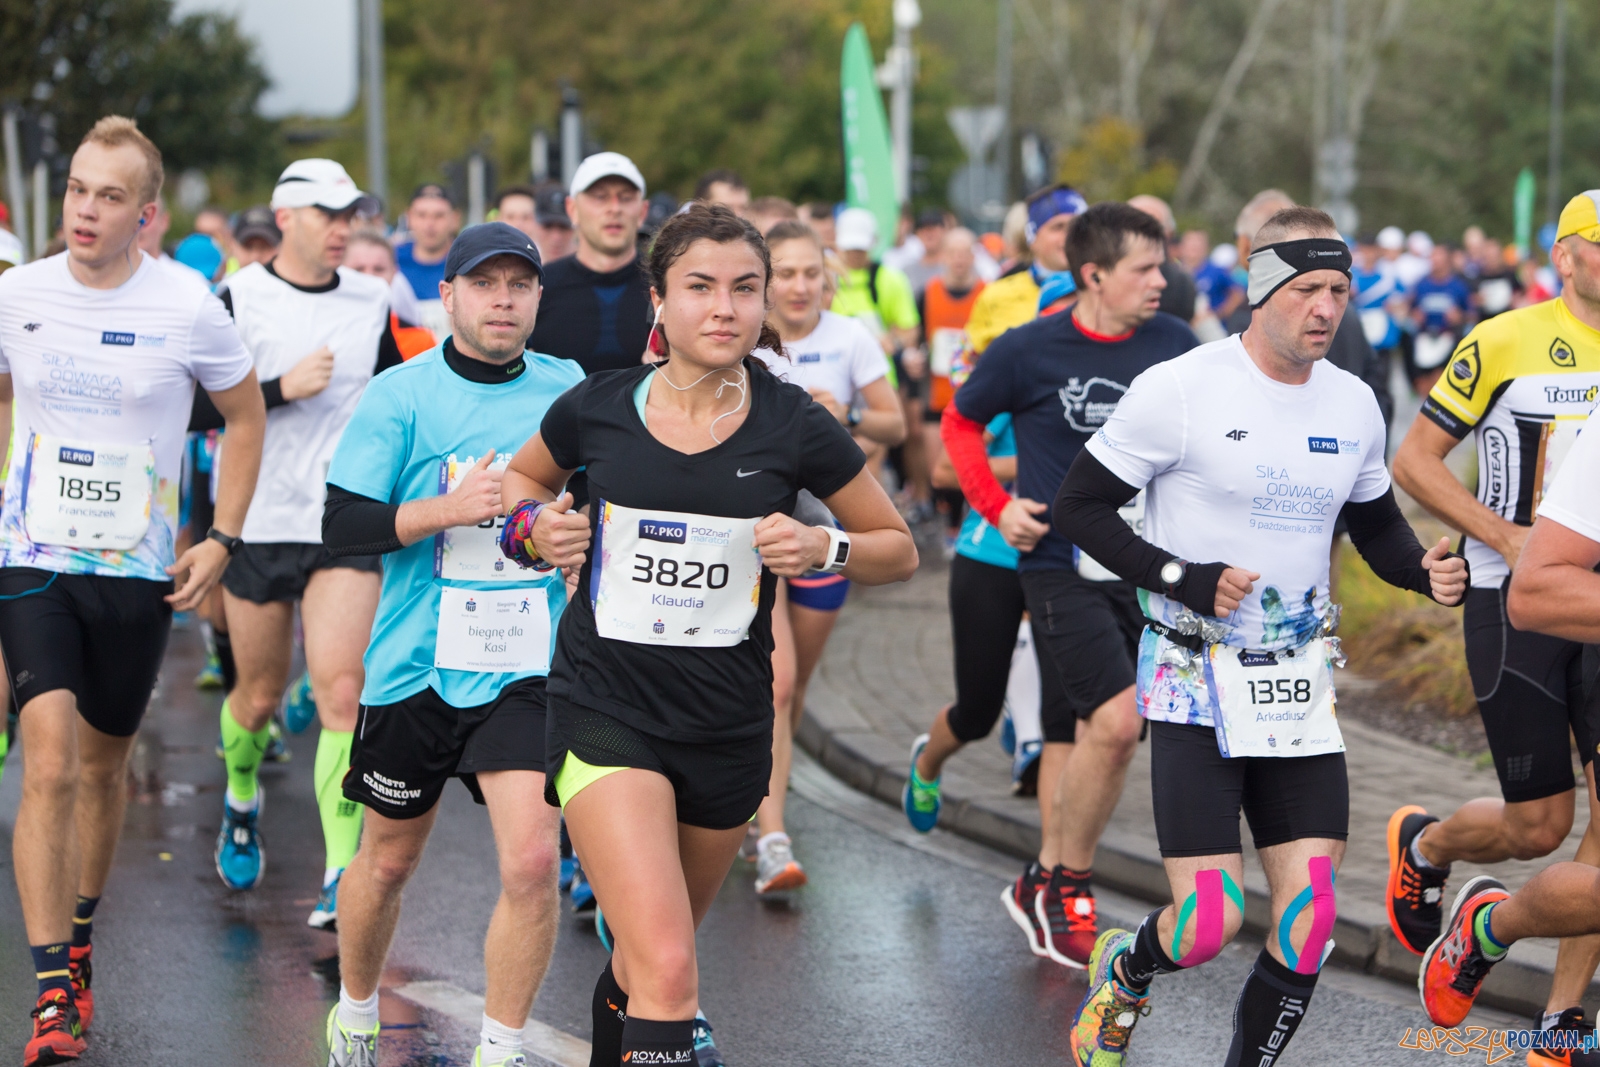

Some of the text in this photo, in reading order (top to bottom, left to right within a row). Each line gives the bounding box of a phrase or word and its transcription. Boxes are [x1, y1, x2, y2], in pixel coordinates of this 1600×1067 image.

[42, 353, 75, 368] SIŁA
[50, 369, 122, 387] ODWAGA
[1225, 429, 1249, 441] 4F
[1256, 465, 1290, 481] SIŁA
[59, 476, 121, 502] 1855
[1266, 482, 1334, 501] ODWAGA
[58, 504, 116, 518] Franciszek
[1252, 497, 1332, 516] SZYBKOŚĆ
[1250, 519, 1256, 528] 9
[1308, 524, 1323, 534] 2016
[690, 535, 729, 545] maraton
[632, 553, 729, 590] 3820
[651, 593, 704, 608] Klaudia
[468, 625, 523, 640] biegnę dla
[684, 627, 701, 635] 4F
[484, 642, 507, 653] Kasi
[1247, 679, 1311, 704] 1358
[1256, 711, 1306, 722] Arkadiusz
[363, 773, 421, 799] CZARNKÓW
[373, 770, 406, 789] MIASTO
[632, 1049, 692, 1060] ROYAL BAY
